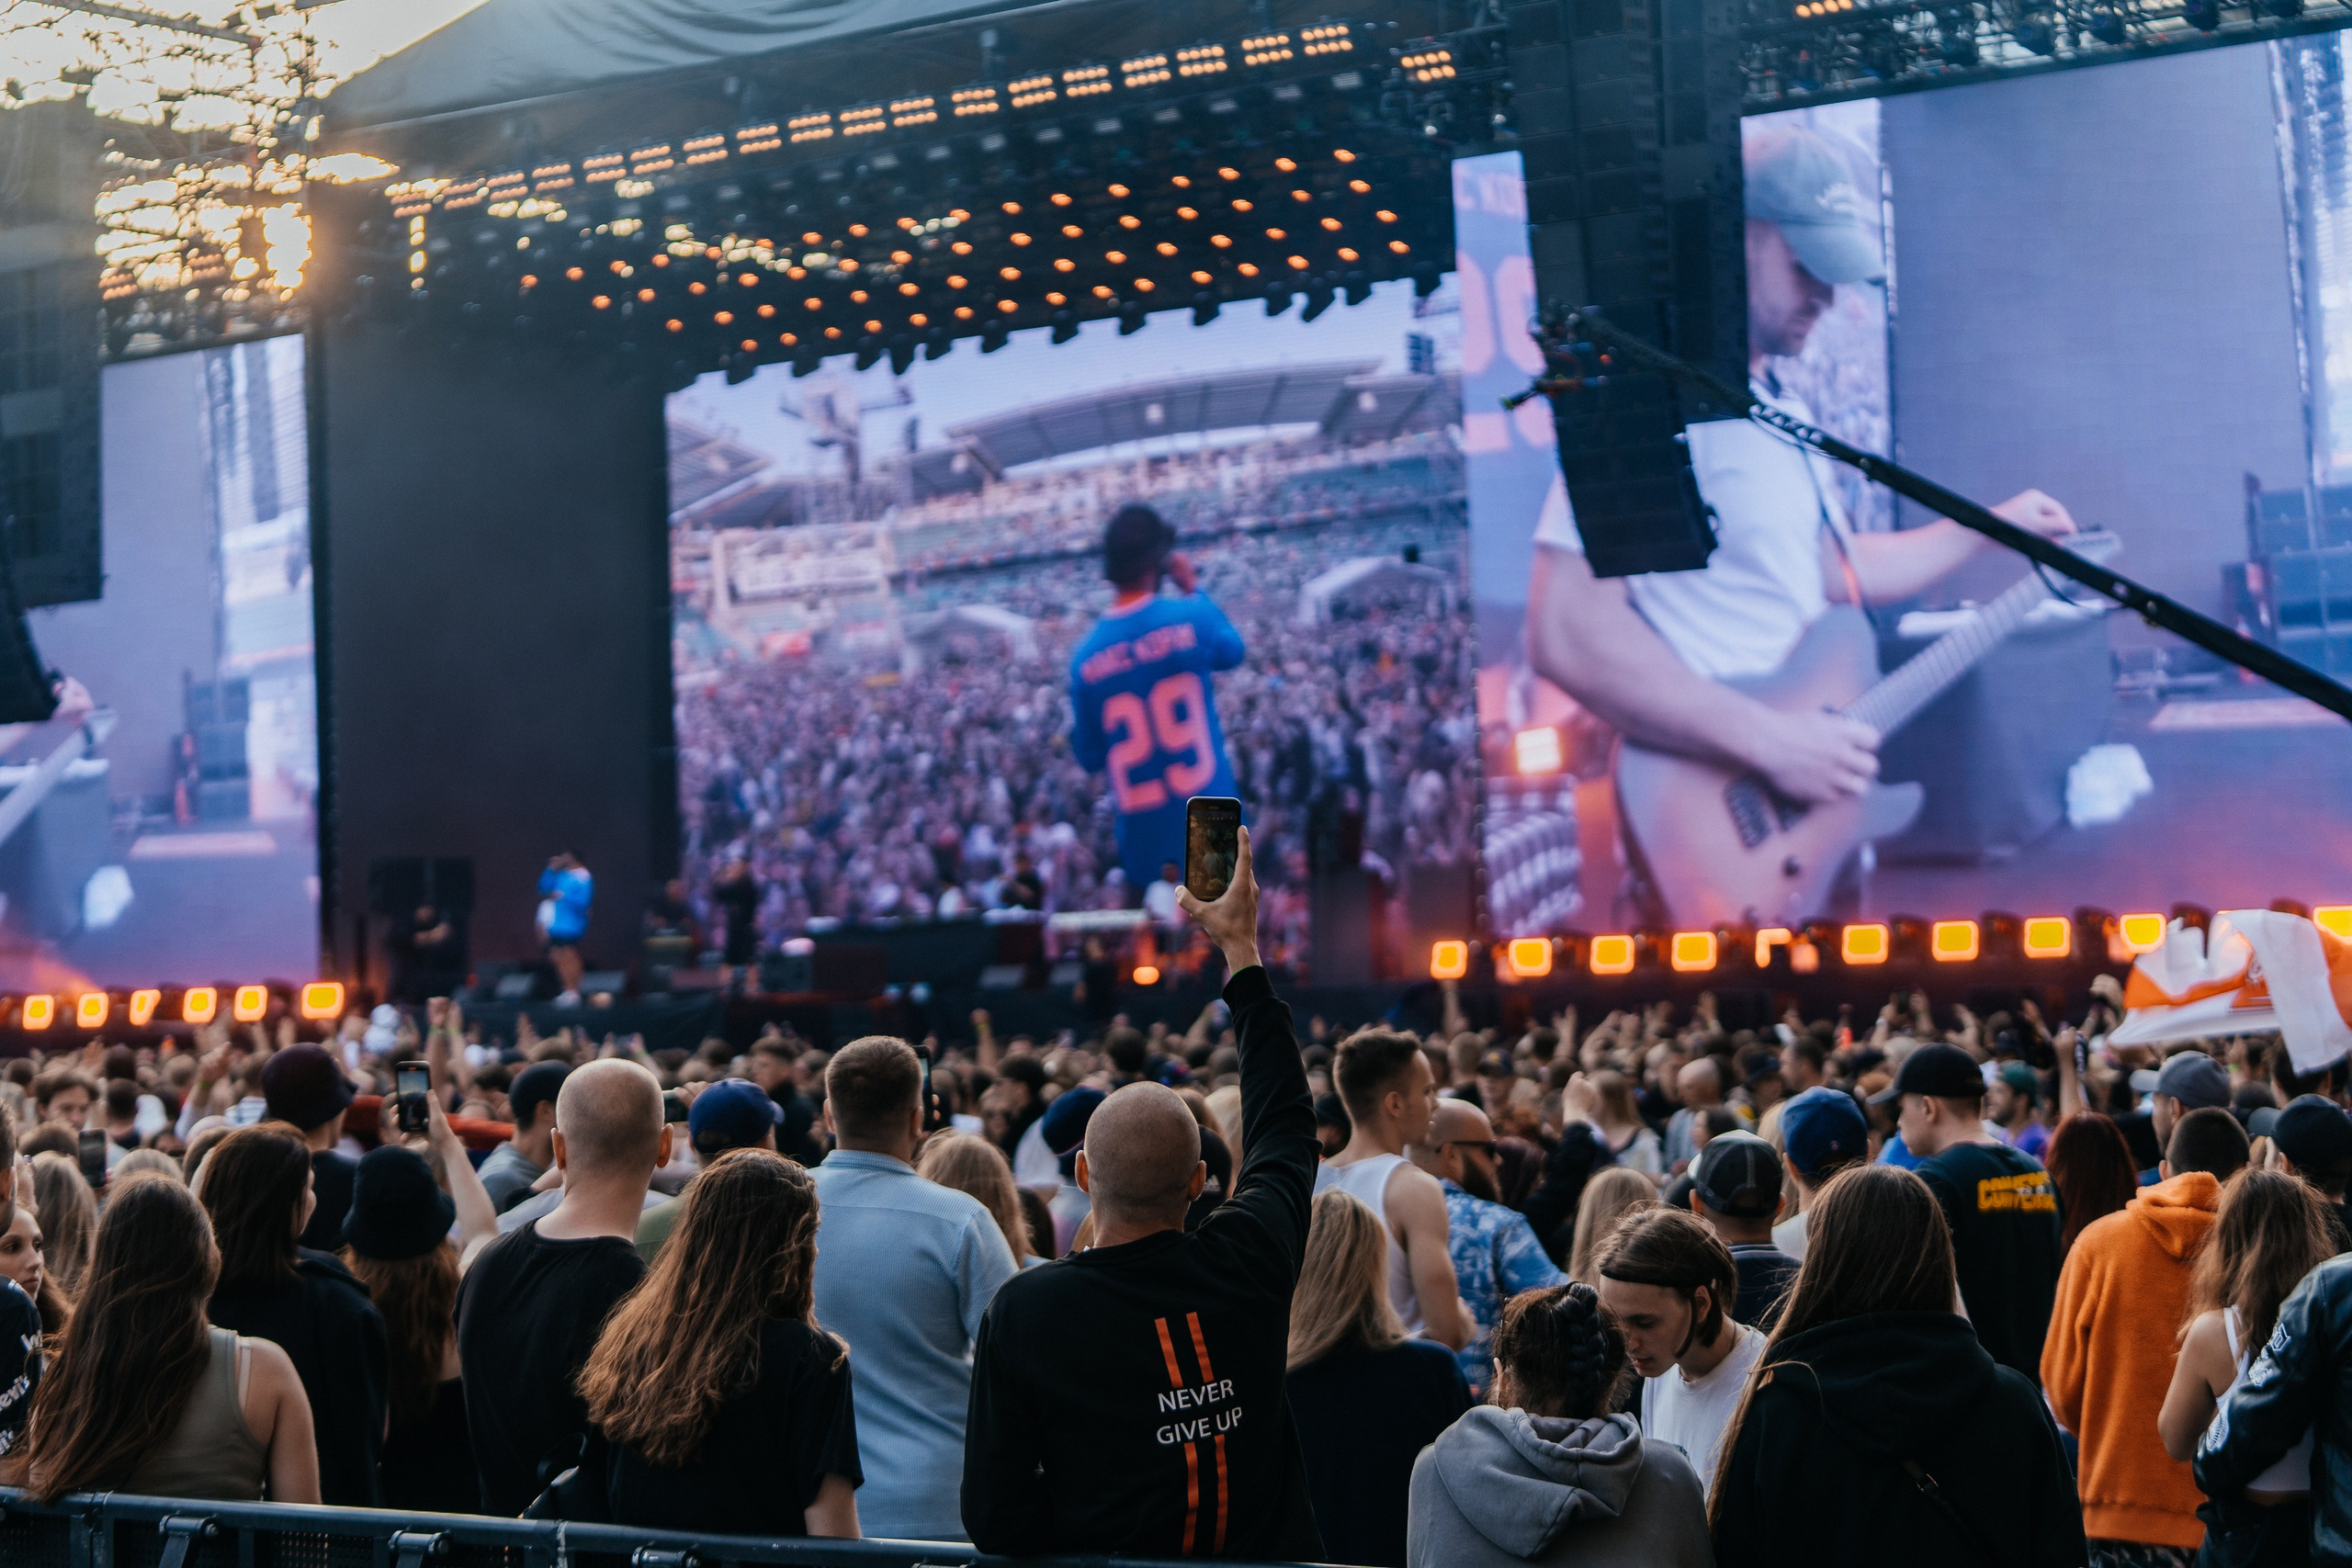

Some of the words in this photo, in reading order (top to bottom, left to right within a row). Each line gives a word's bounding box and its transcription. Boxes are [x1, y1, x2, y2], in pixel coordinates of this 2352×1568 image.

[1102, 671, 1217, 815] 29
[0, 1374, 30, 1412] evi's
[1158, 1379, 1235, 1413] NEVER
[1156, 1417, 1212, 1445] GIVE
[1216, 1405, 1243, 1432] UP
